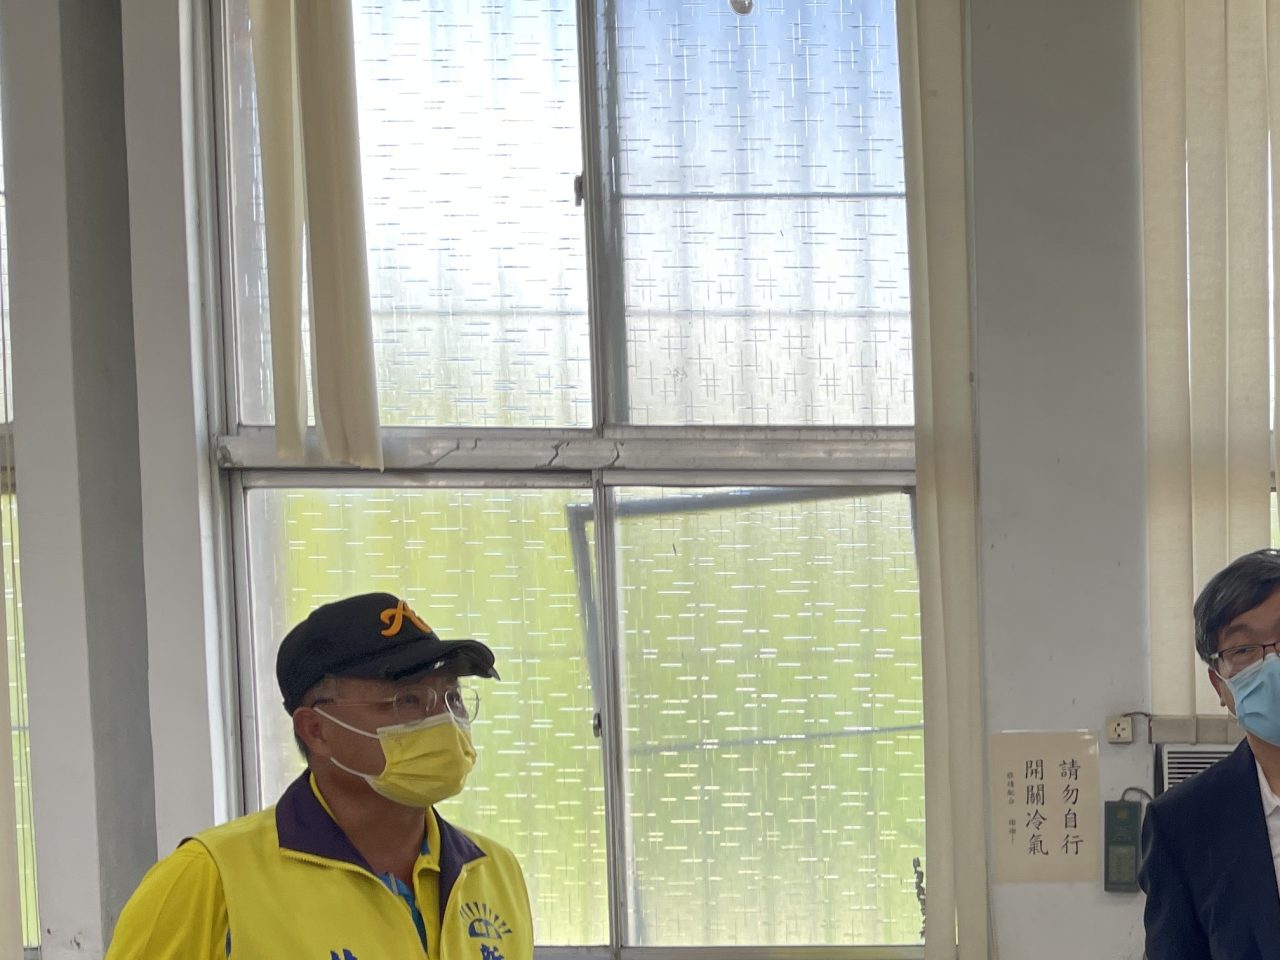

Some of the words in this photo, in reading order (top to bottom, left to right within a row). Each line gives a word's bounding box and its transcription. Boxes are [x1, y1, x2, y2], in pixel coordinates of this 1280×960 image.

[1025, 759, 1049, 856] 開關冷氣
[1059, 758, 1084, 855] 請勿自行
